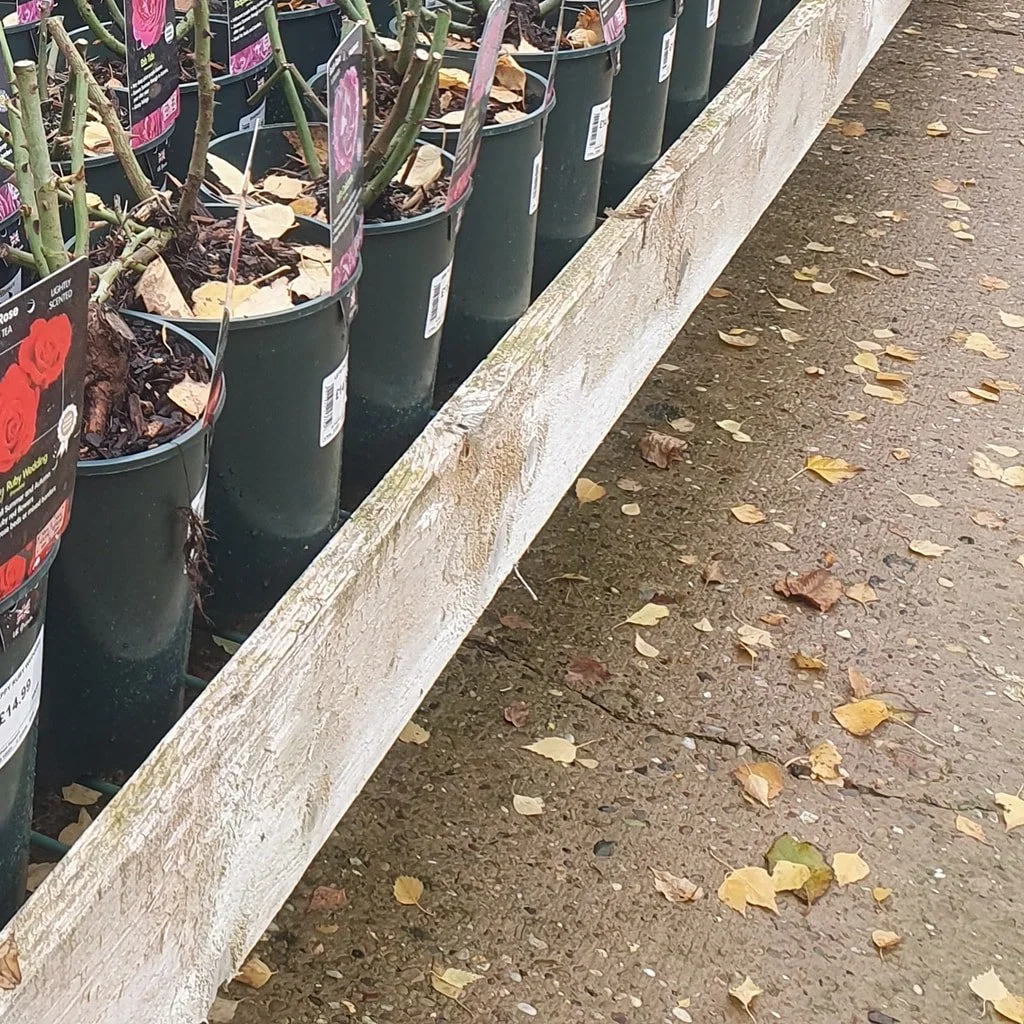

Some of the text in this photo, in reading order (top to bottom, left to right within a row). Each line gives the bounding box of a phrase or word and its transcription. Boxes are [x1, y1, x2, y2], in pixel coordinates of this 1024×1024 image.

[50, 278, 72, 297] LIGHTLY
[49, 289, 73, 310] SCENTED
[2, 325, 13, 337] TEA
[6, 474, 22, 492] Ruby
[23, 453, 48, 479] Wedding
